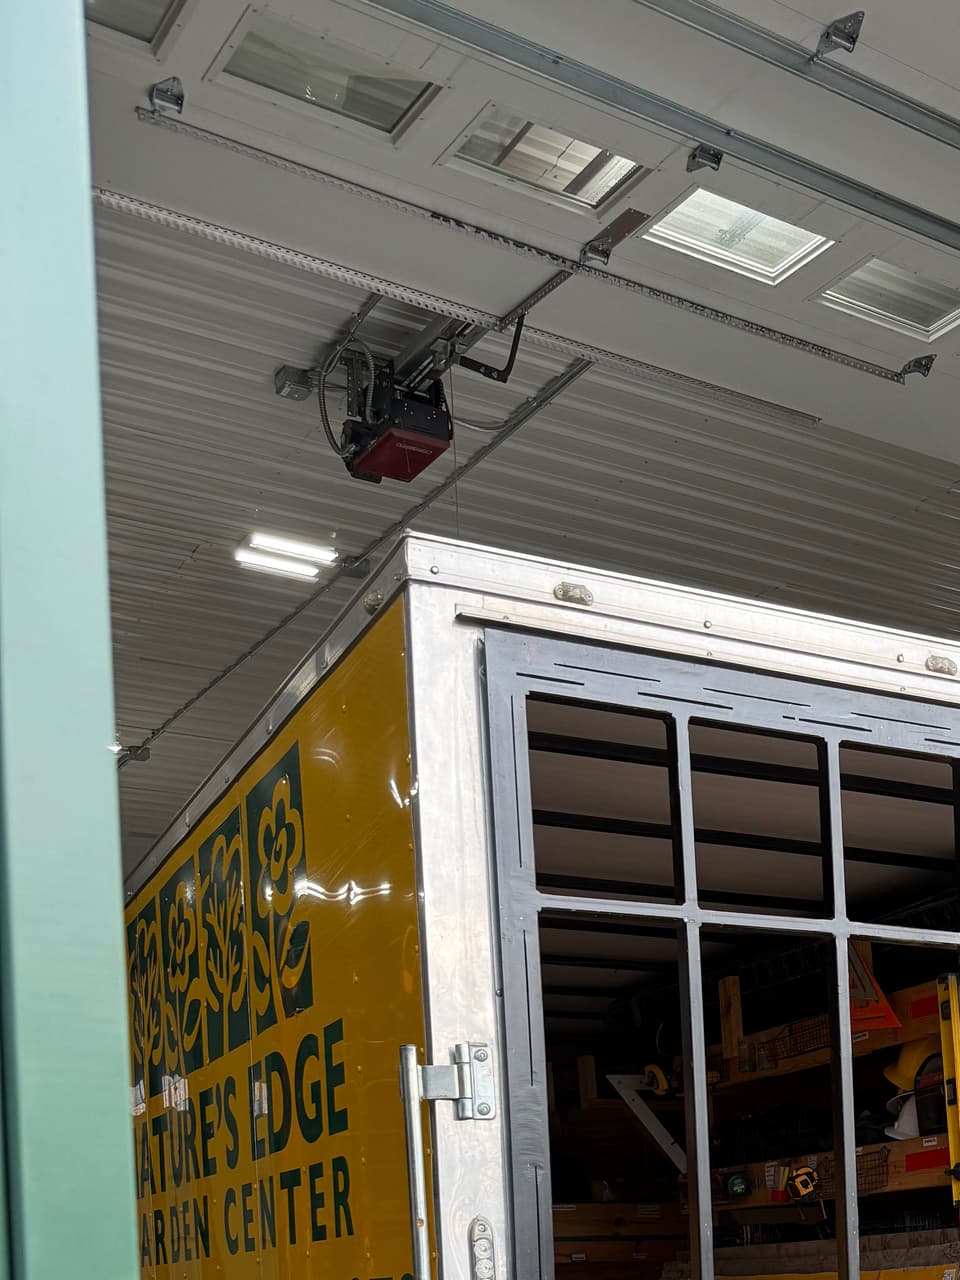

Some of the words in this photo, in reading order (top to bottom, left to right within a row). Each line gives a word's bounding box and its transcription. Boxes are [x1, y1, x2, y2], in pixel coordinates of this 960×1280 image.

[136, 1076, 239, 1199] ATURE'S
[248, 1018, 348, 1161] EDGE
[141, 1195, 210, 1267] ARDEN
[224, 1156, 354, 1255] CENTER
